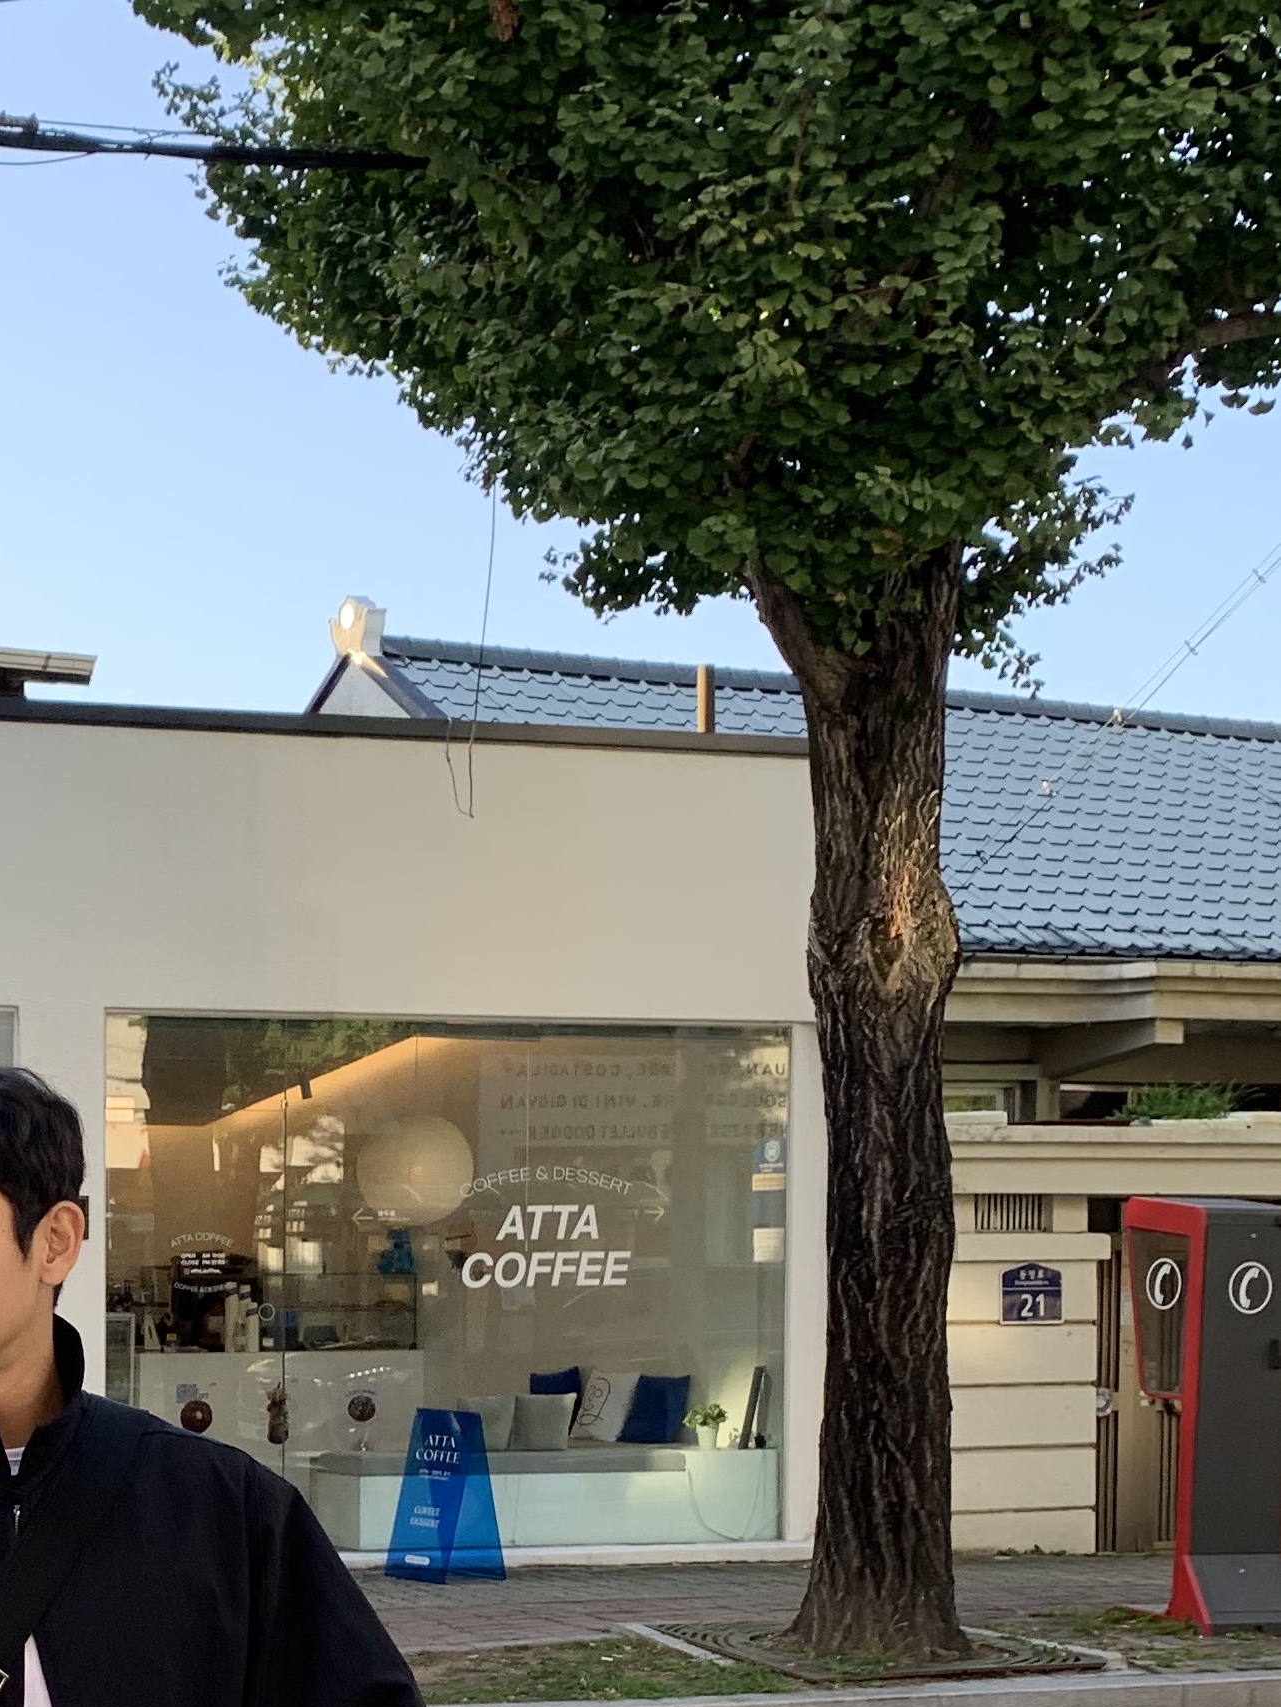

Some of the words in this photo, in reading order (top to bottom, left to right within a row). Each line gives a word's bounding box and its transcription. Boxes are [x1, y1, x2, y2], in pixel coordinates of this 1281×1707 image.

[459, 1166, 531, 1198] COFFEE
[535, 1165, 548, 1181] &
[553, 1166, 633, 1196] DESSERT
[495, 1203, 600, 1242] ATTA
[170, 1232, 194, 1249] ATTA
[194, 1231, 235, 1249] COFFEE
[461, 1250, 632, 1290] COFFEE
[1020, 1293, 1045, 1318] 21
[424, 1434, 457, 1449] ATTA
[415, 1448, 462, 1465] COFFEE
